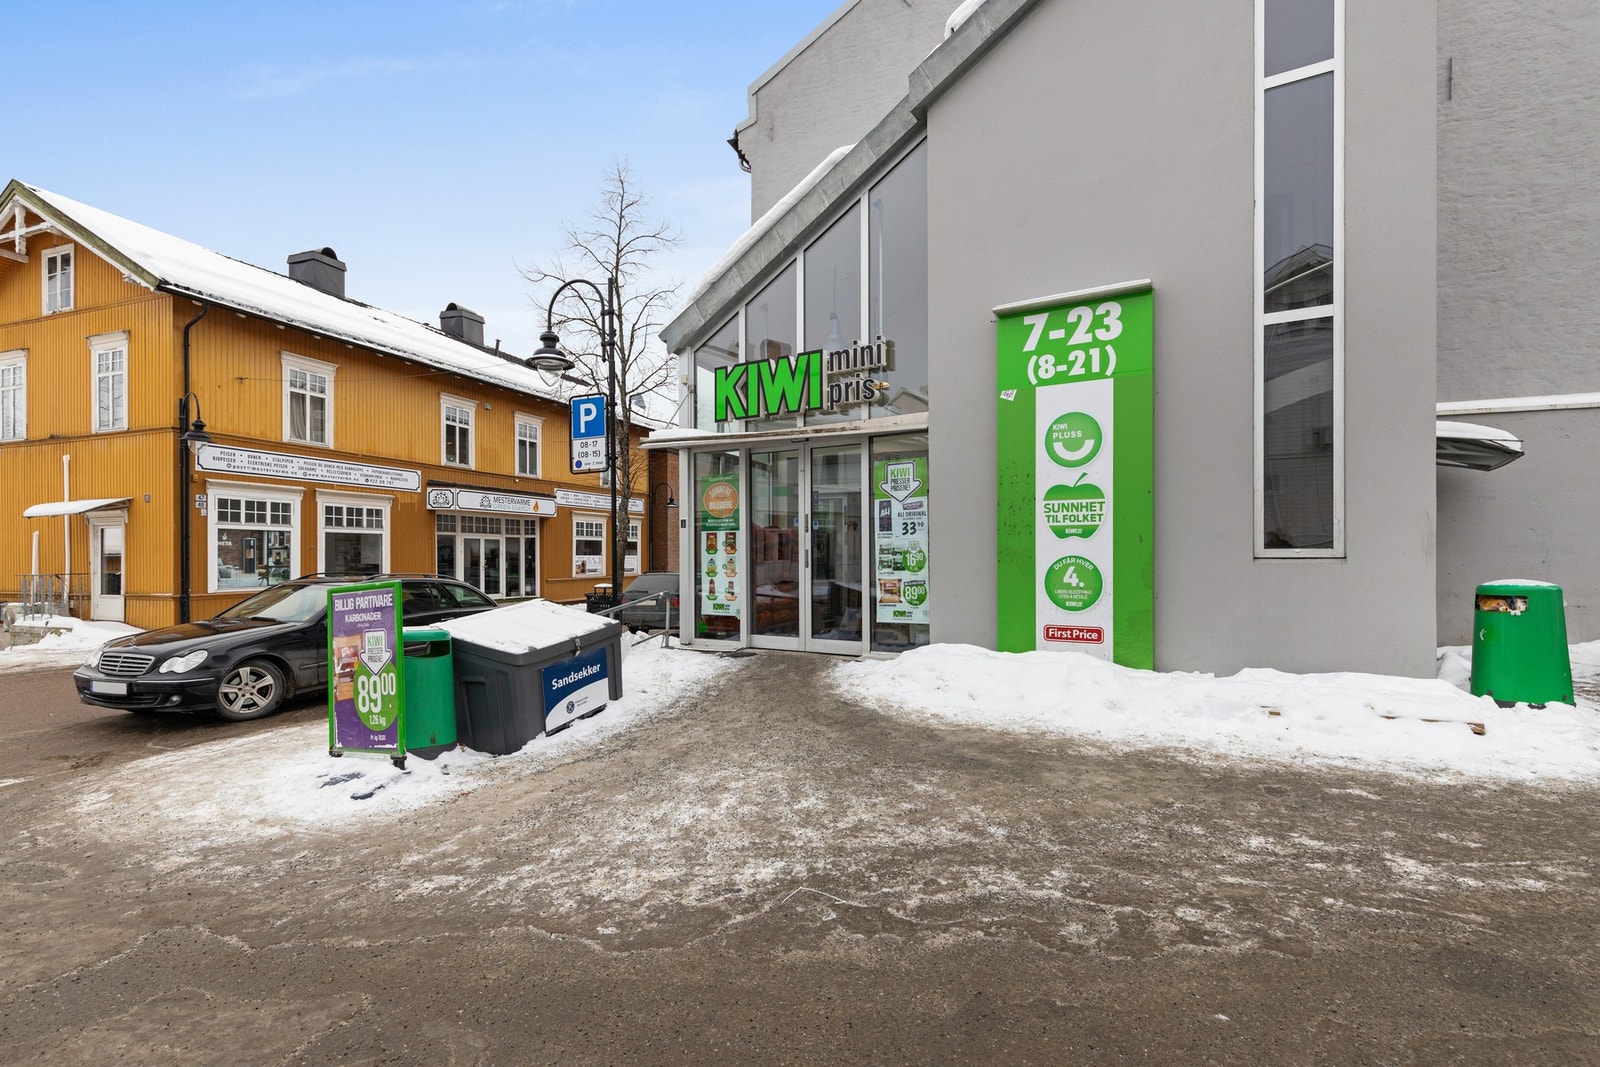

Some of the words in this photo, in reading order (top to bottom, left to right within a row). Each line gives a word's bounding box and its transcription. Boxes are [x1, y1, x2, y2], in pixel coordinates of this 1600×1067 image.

[1022, 301, 1122, 352] 7-23
[829, 336, 882, 372] mini
[1027, 344, 1116, 385] (8-21)
[714, 349, 823, 423] KIWI
[829, 373, 875, 410] pris
[580, 403, 596, 434] P
[1052, 430, 1082, 439] PLUSS
[890, 467, 910, 477] KIWI
[493, 496, 531, 506] MESTERVARME
[1044, 501, 1105, 513] SUNNHET
[880, 507, 890, 517] ALI
[1045, 515, 1061, 523] TIL
[1063, 514, 1103, 523] FOLKET
[1054, 561, 1063, 570] DU
[1076, 559, 1094, 570] HVER
[1063, 566, 1085, 587] 4.
[334, 598, 354, 611] BILLIG
[356, 594, 393, 609] PARTIVARE
[345, 612, 381, 622] KARBONADER
[1048, 628, 1071, 638] First
[1073, 630, 1098, 640] Price
[367, 636, 383, 646] KIWI
[552, 664, 600, 690] Sandsekker
[379, 715, 386, 726] kg
